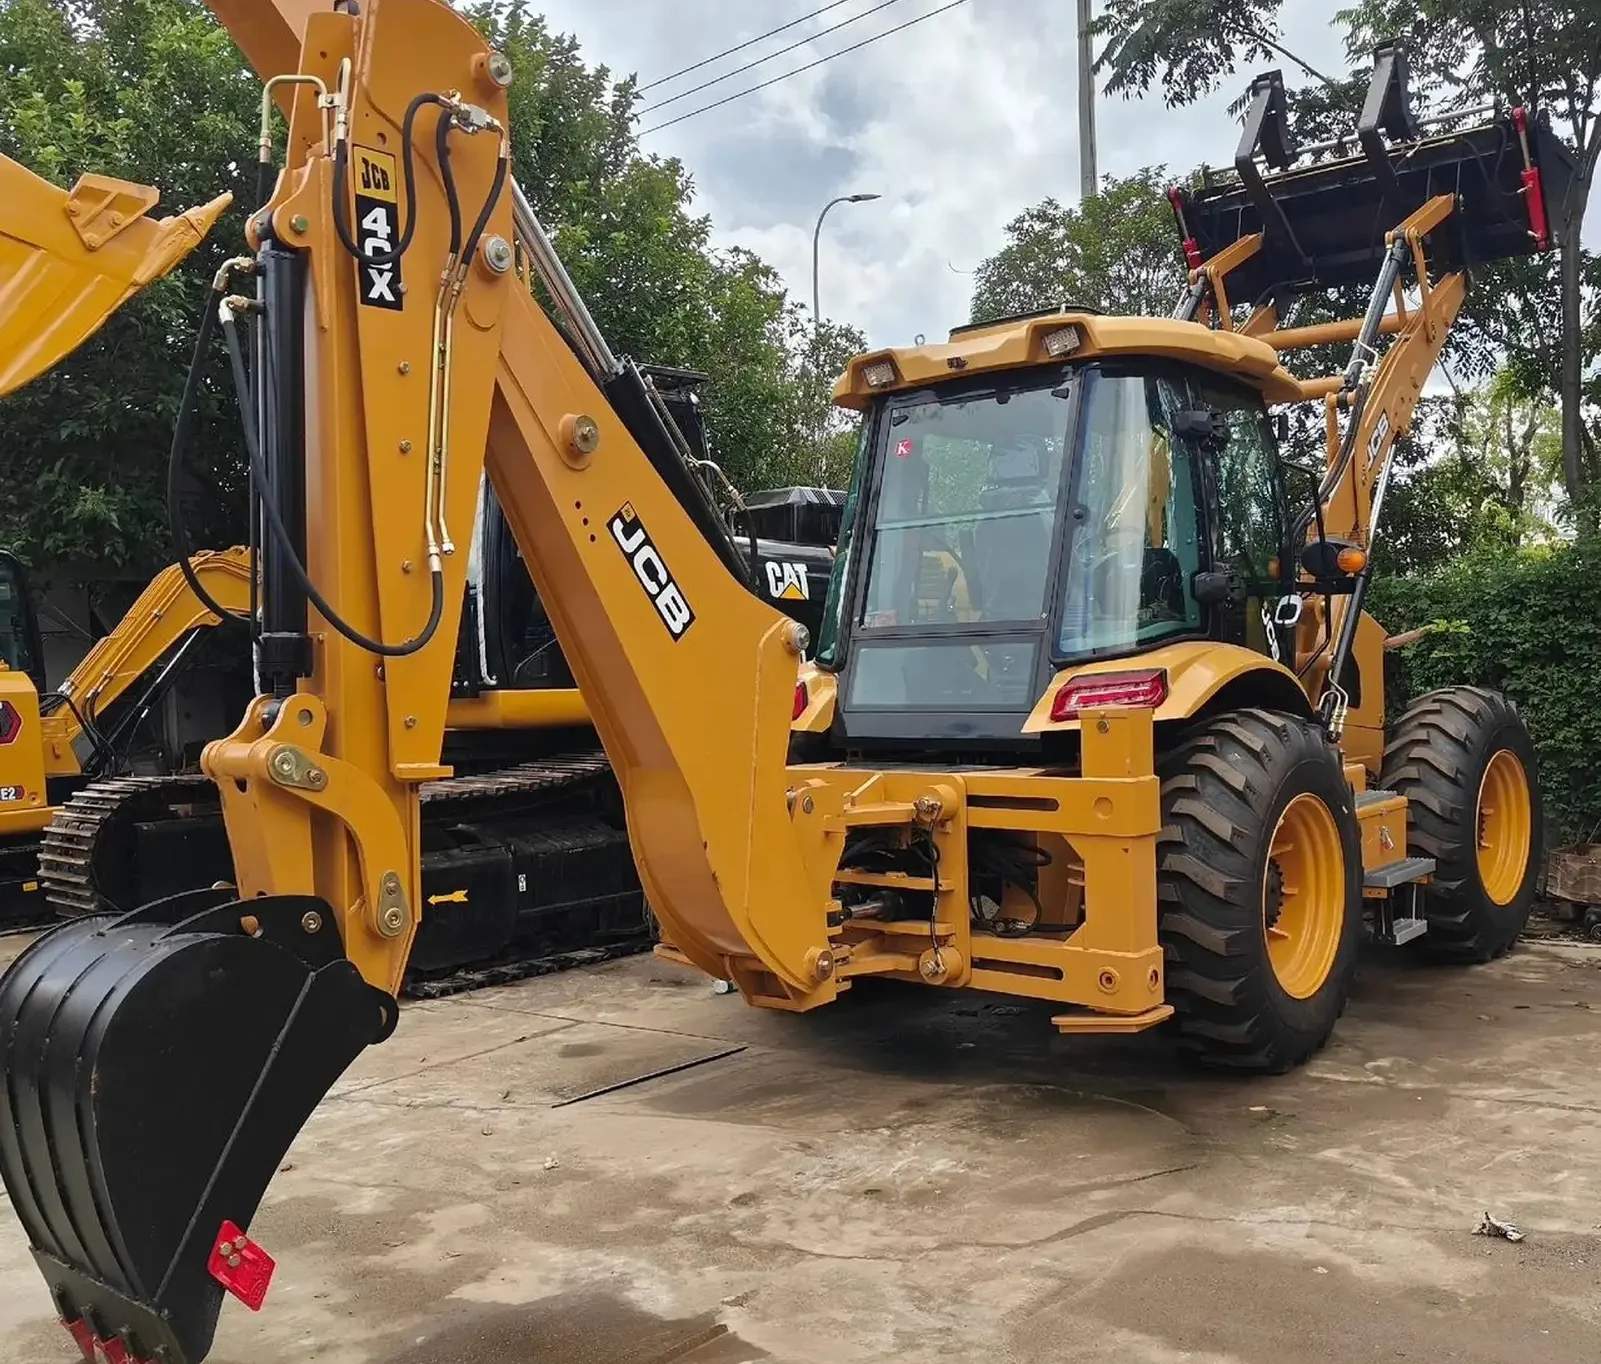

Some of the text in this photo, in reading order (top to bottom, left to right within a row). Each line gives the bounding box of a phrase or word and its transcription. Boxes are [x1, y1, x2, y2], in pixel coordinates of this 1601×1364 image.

[361, 156, 390, 191] JCB
[1367, 412, 1389, 471] JCB
[612, 517, 690, 634] JCB
[765, 561, 810, 600] CAT
